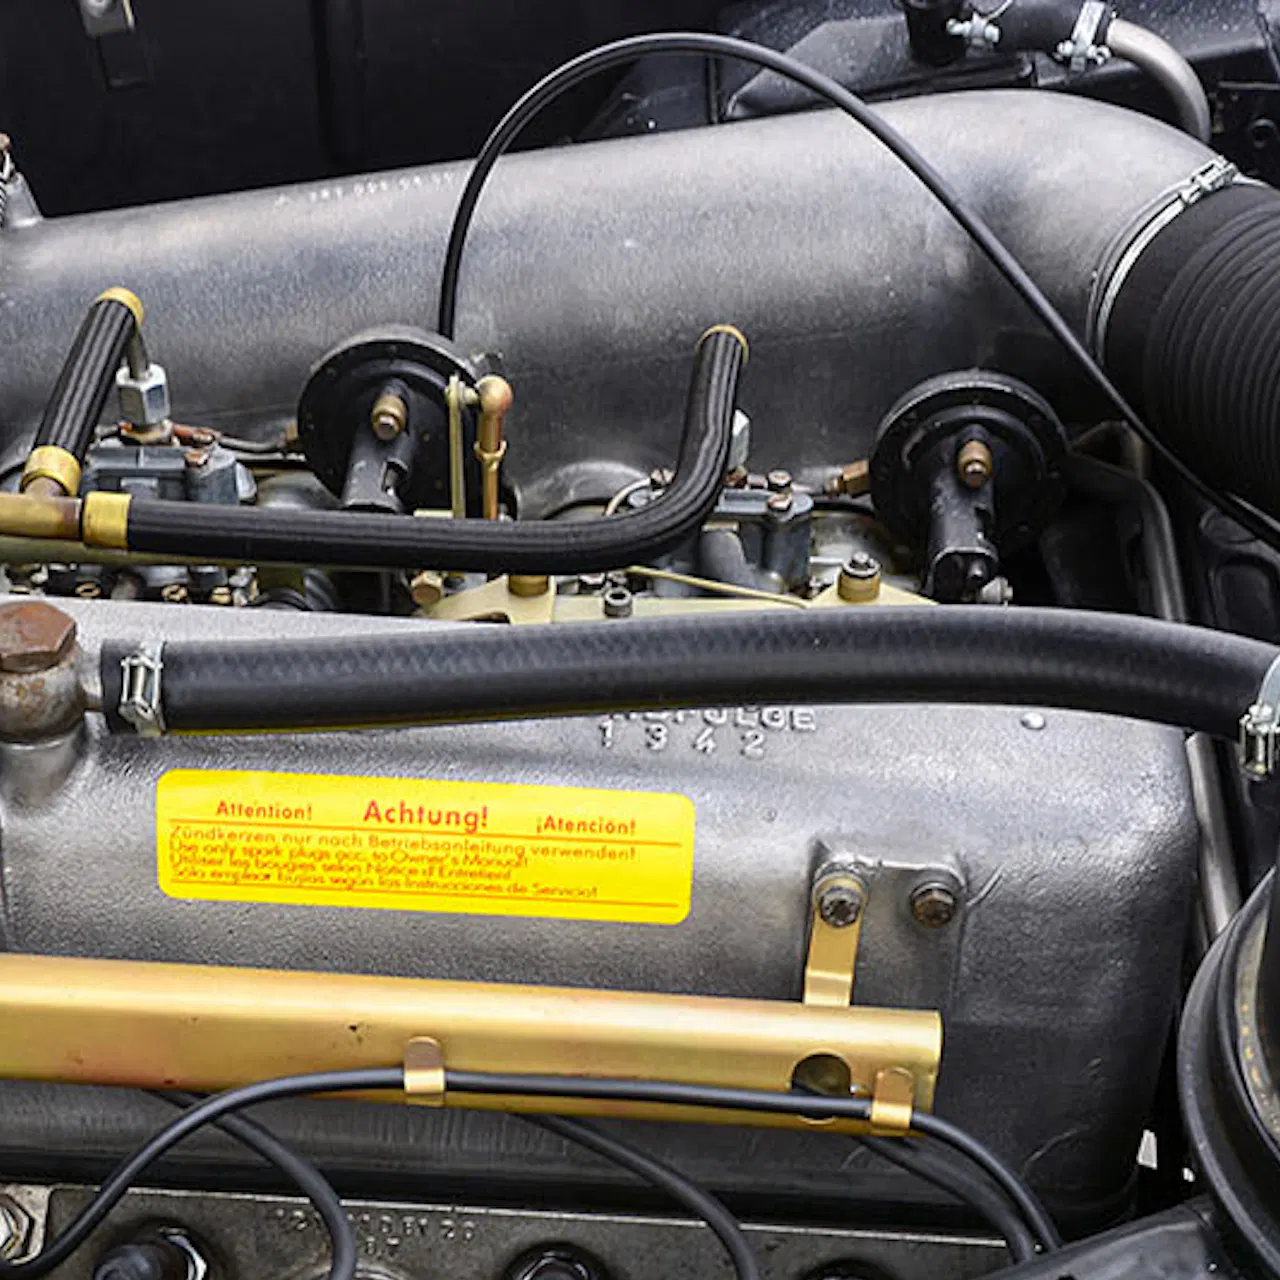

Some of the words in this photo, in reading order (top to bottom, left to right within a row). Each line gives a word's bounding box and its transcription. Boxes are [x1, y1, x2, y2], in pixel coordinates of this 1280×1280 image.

[739, 729, 765, 757] 2
[216, 800, 313, 820] Attention!
[364, 799, 488, 834] Achtung!
[536, 815, 637, 836] ¡Atención!
[170, 826, 275, 844] Zündkerzen
[282, 833, 311, 846] nur
[318, 831, 363, 848] nach
[369, 834, 526, 857] Betriebsanleitung
[530, 846, 636, 861] verwenden!
